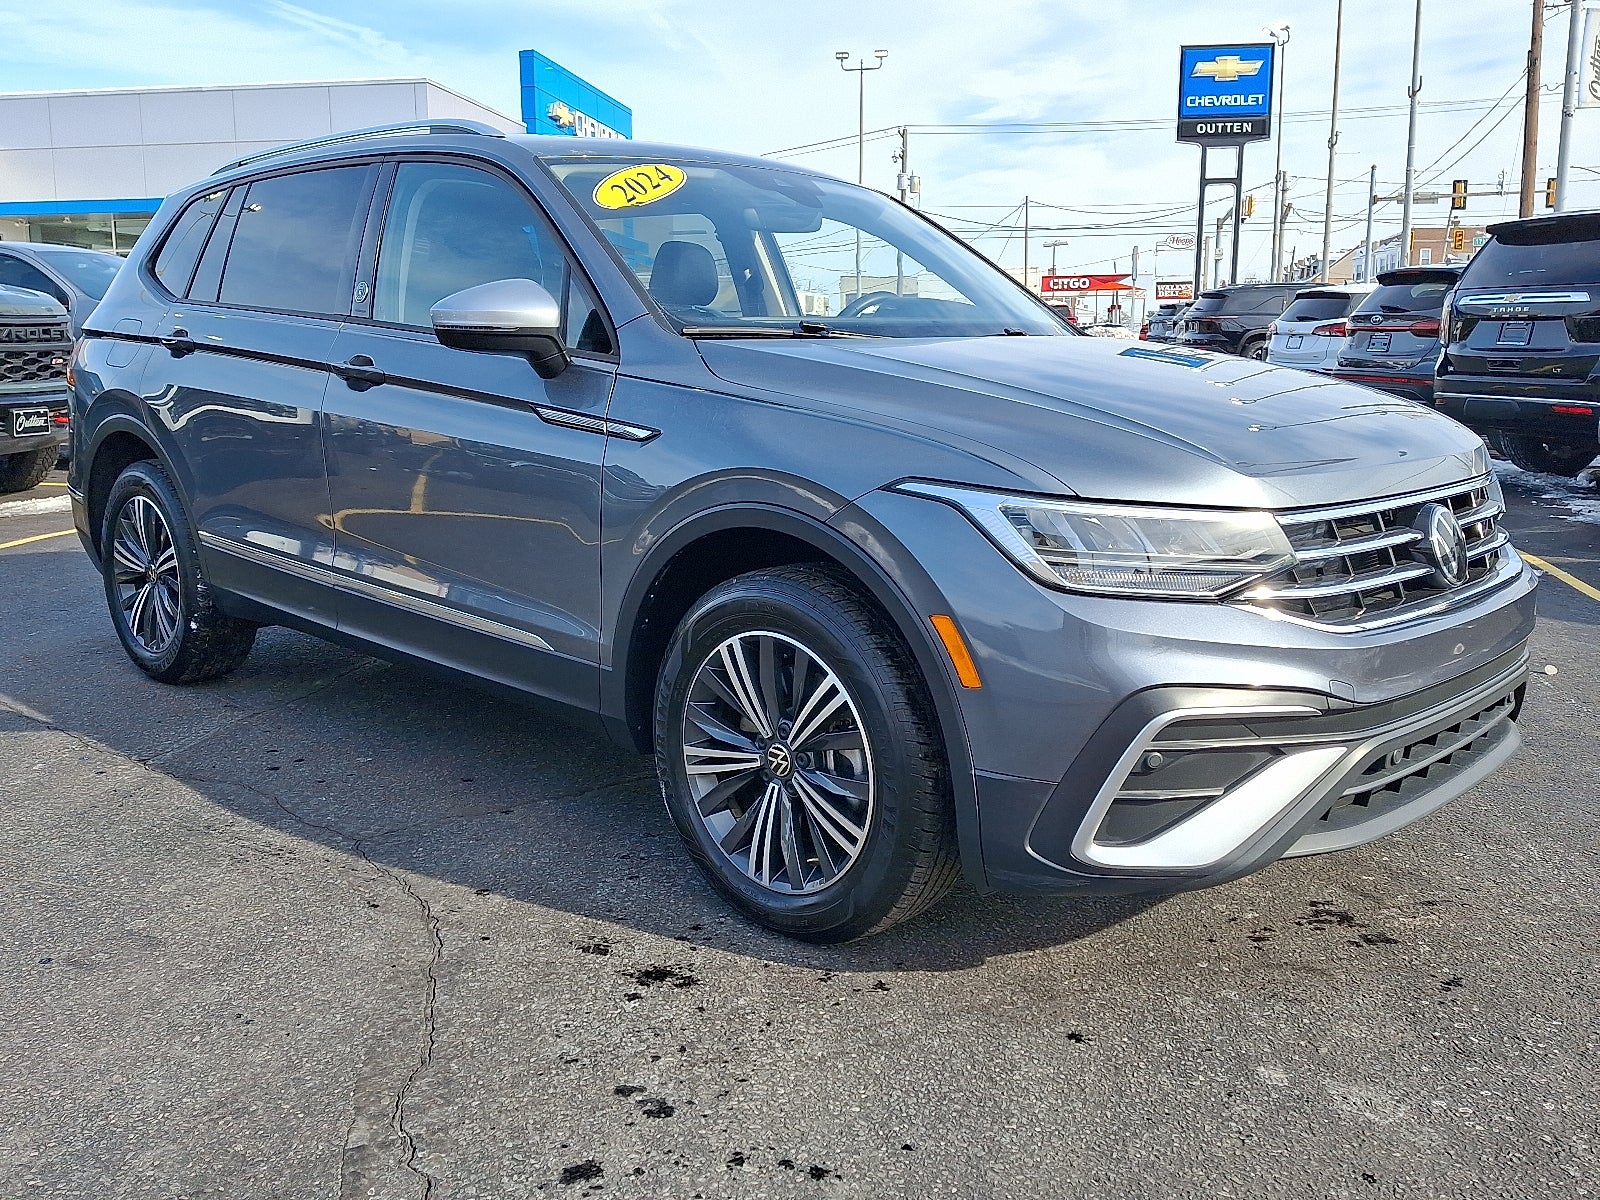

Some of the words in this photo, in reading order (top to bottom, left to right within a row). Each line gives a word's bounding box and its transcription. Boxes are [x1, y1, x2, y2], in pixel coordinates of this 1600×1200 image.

[1186, 94, 1266, 107] CHEVROLET
[1196, 122, 1252, 134] OUTTEN
[611, 165, 674, 203] 2024
[1049, 277, 1090, 289] CITGO
